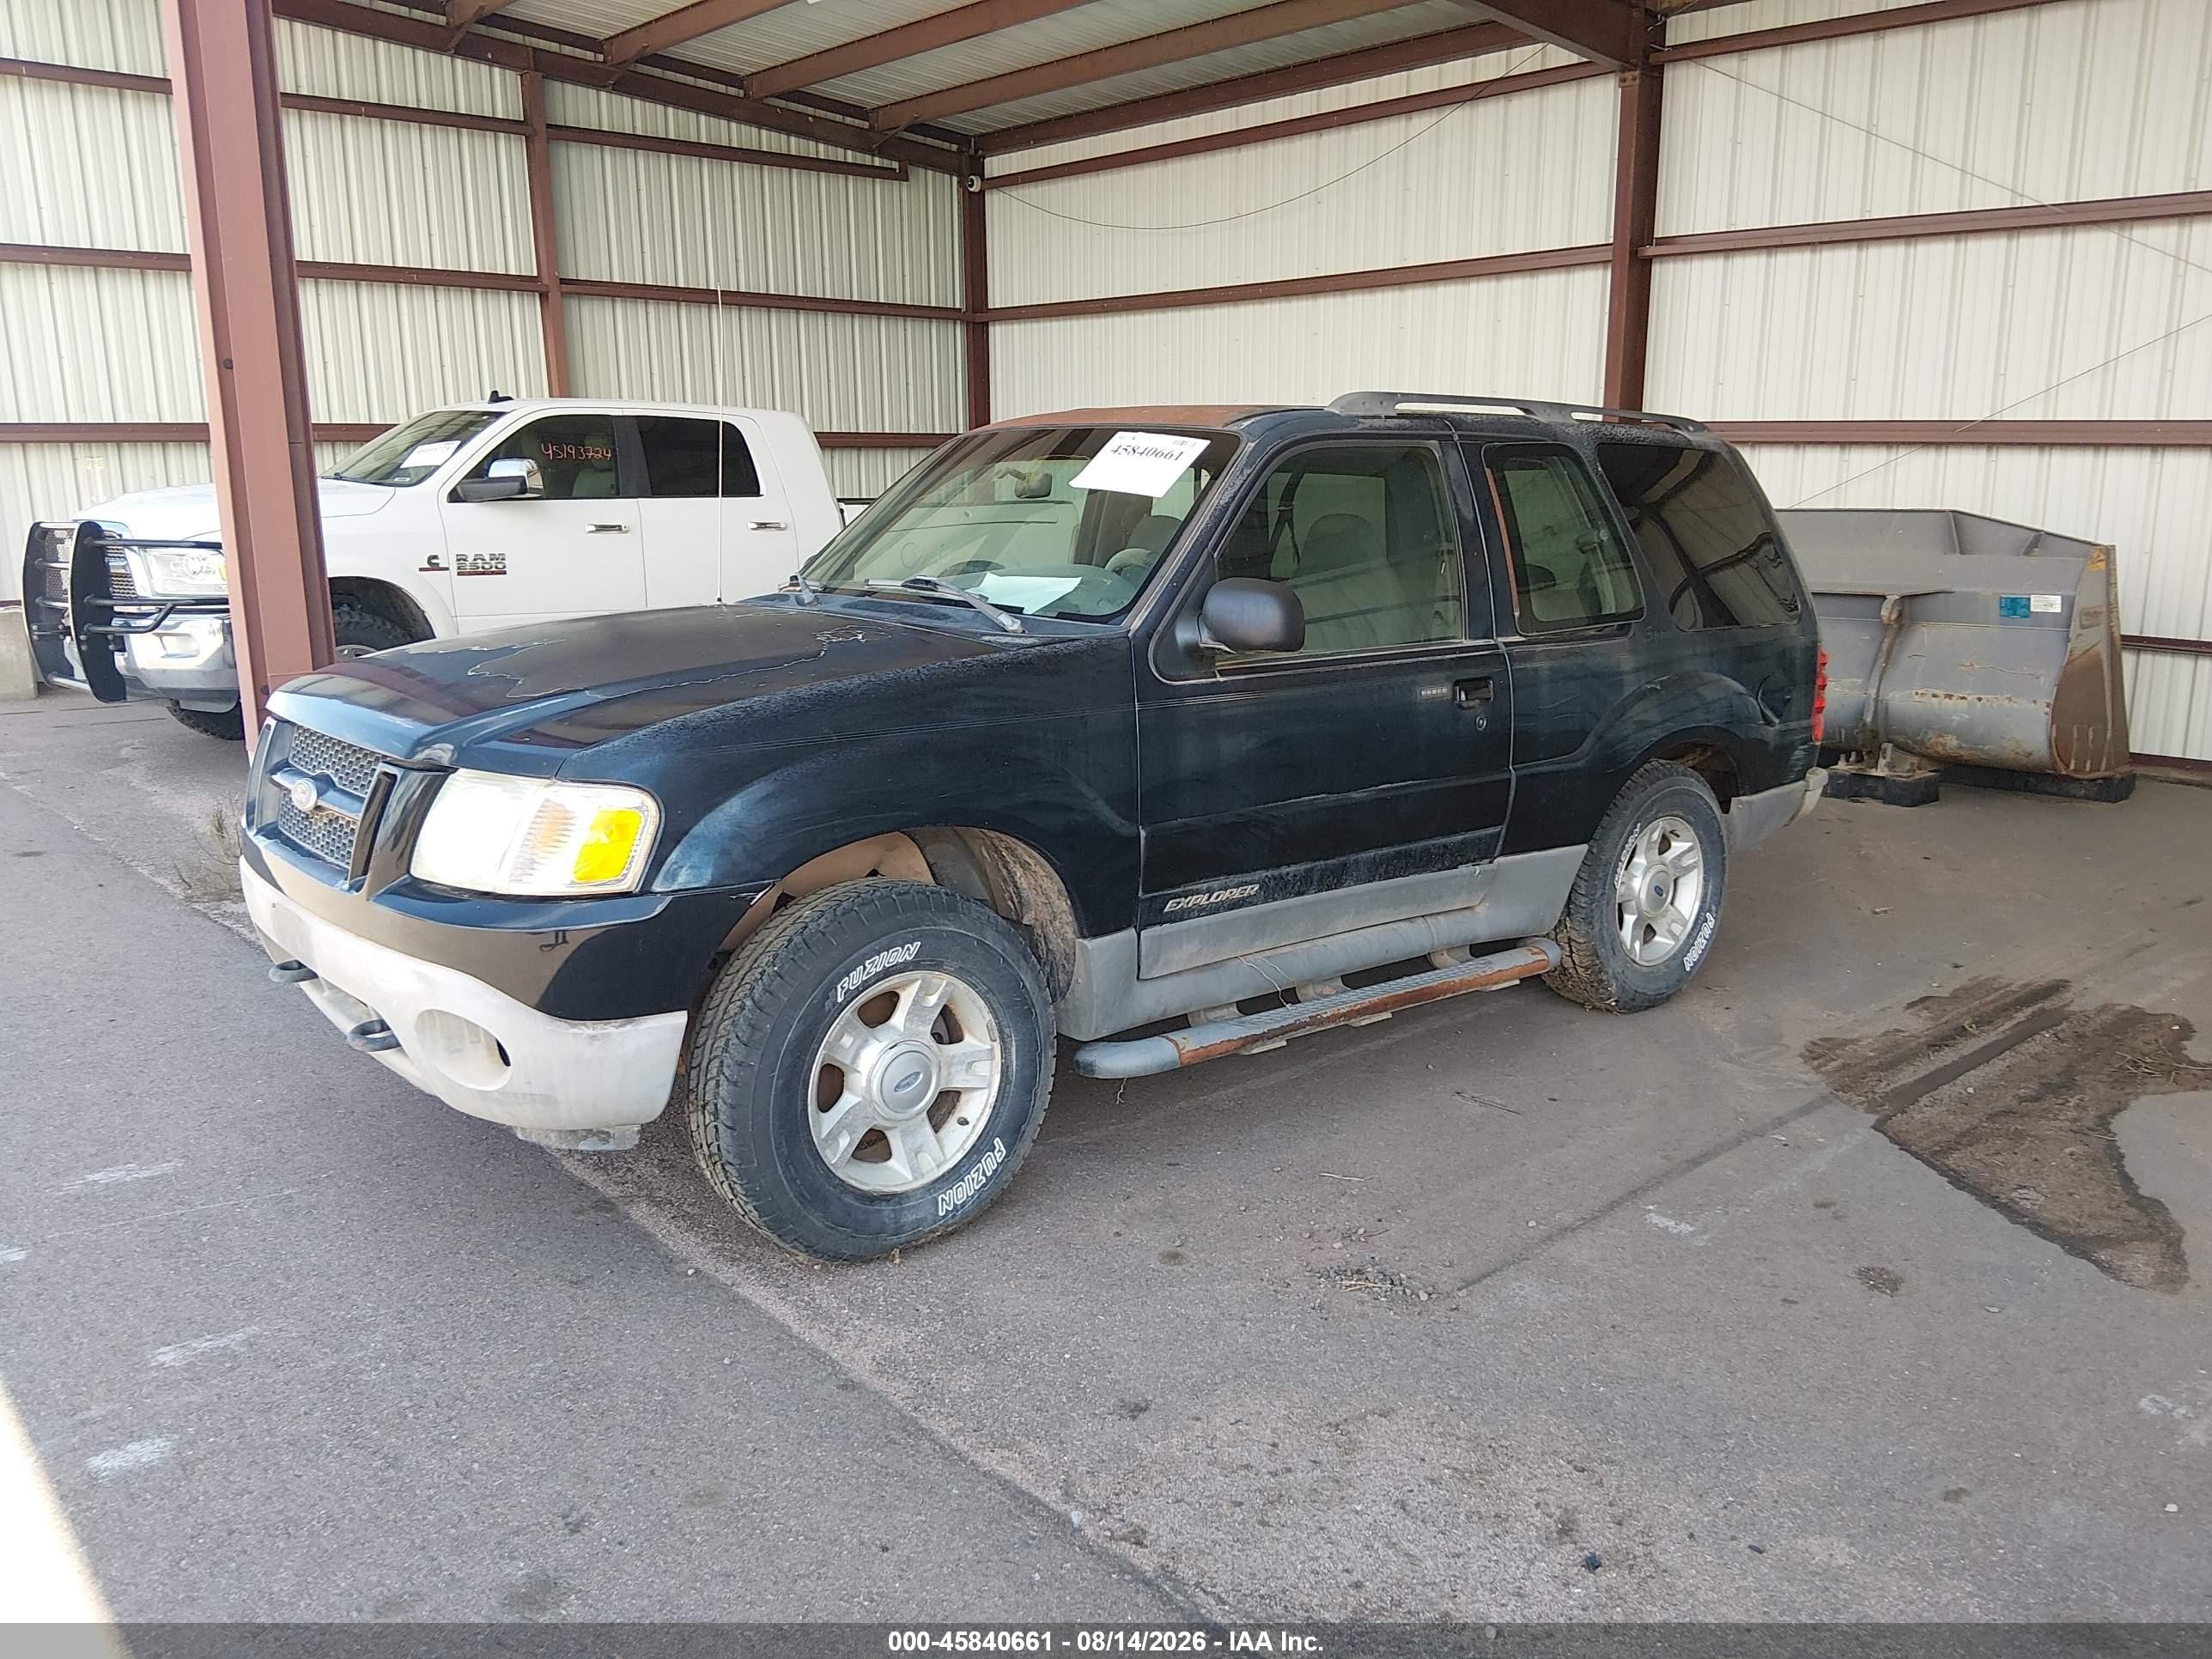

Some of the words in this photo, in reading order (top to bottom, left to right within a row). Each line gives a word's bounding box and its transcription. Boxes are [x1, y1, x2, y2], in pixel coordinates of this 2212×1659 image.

[541, 442, 612, 460] 45193724
[1110, 444, 1185, 461] 45840661
[455, 552, 507, 562] RAM
[456, 561, 507, 571] 2500
[1163, 883, 1261, 913] EXPLORER
[1683, 911, 1716, 972] FUZION
[837, 941, 921, 1003] FUZION
[938, 1137, 1007, 1217] FUZION
